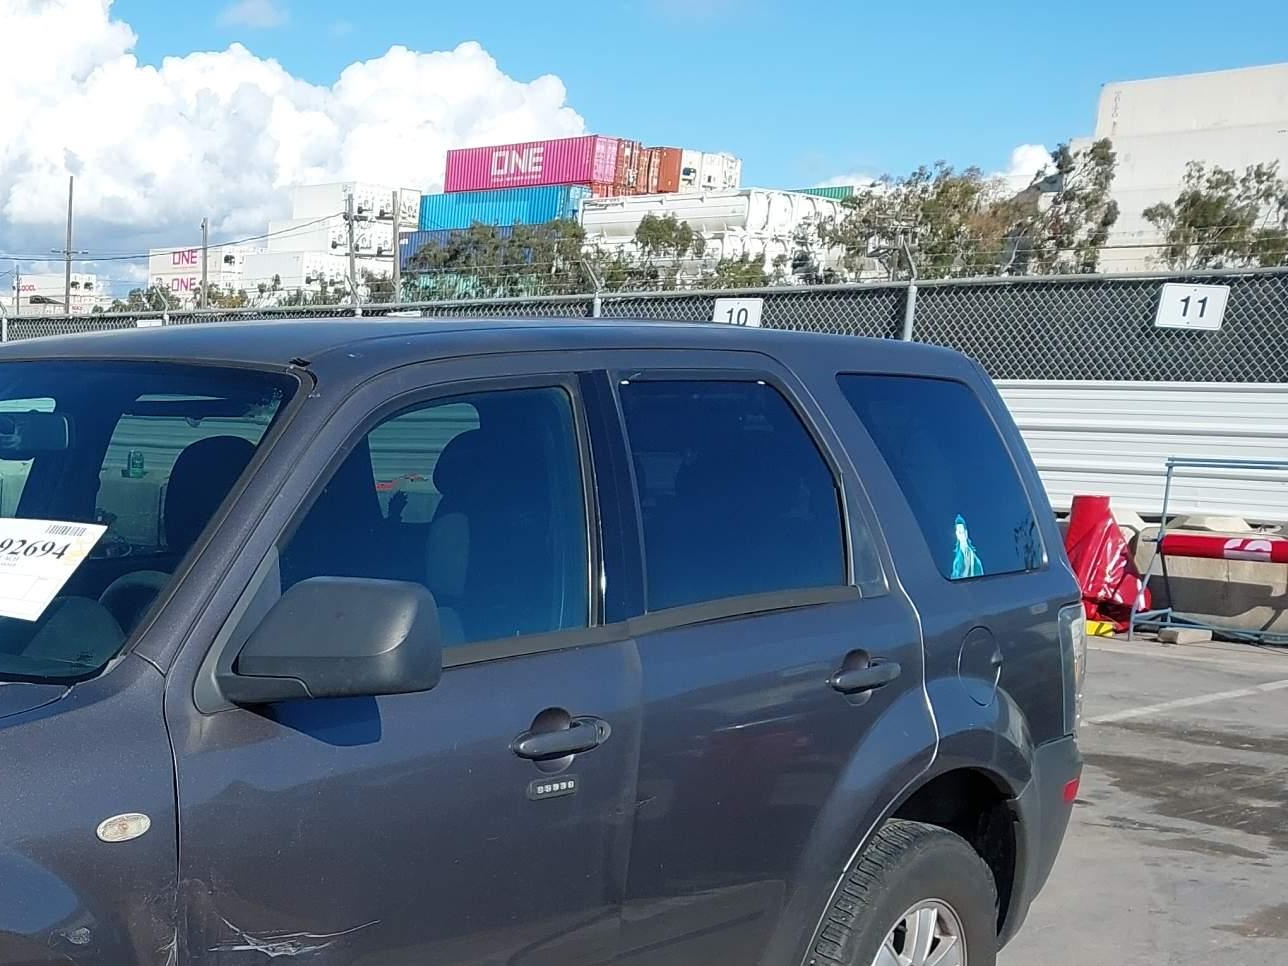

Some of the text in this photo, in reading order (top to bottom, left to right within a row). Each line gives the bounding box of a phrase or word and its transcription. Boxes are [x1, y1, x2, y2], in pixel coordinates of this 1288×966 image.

[491, 147, 544, 175] ONE
[172, 250, 198, 265] ONE
[171, 277, 196, 291] ONE
[1180, 295, 1209, 318] 11
[726, 307, 748, 326] 10
